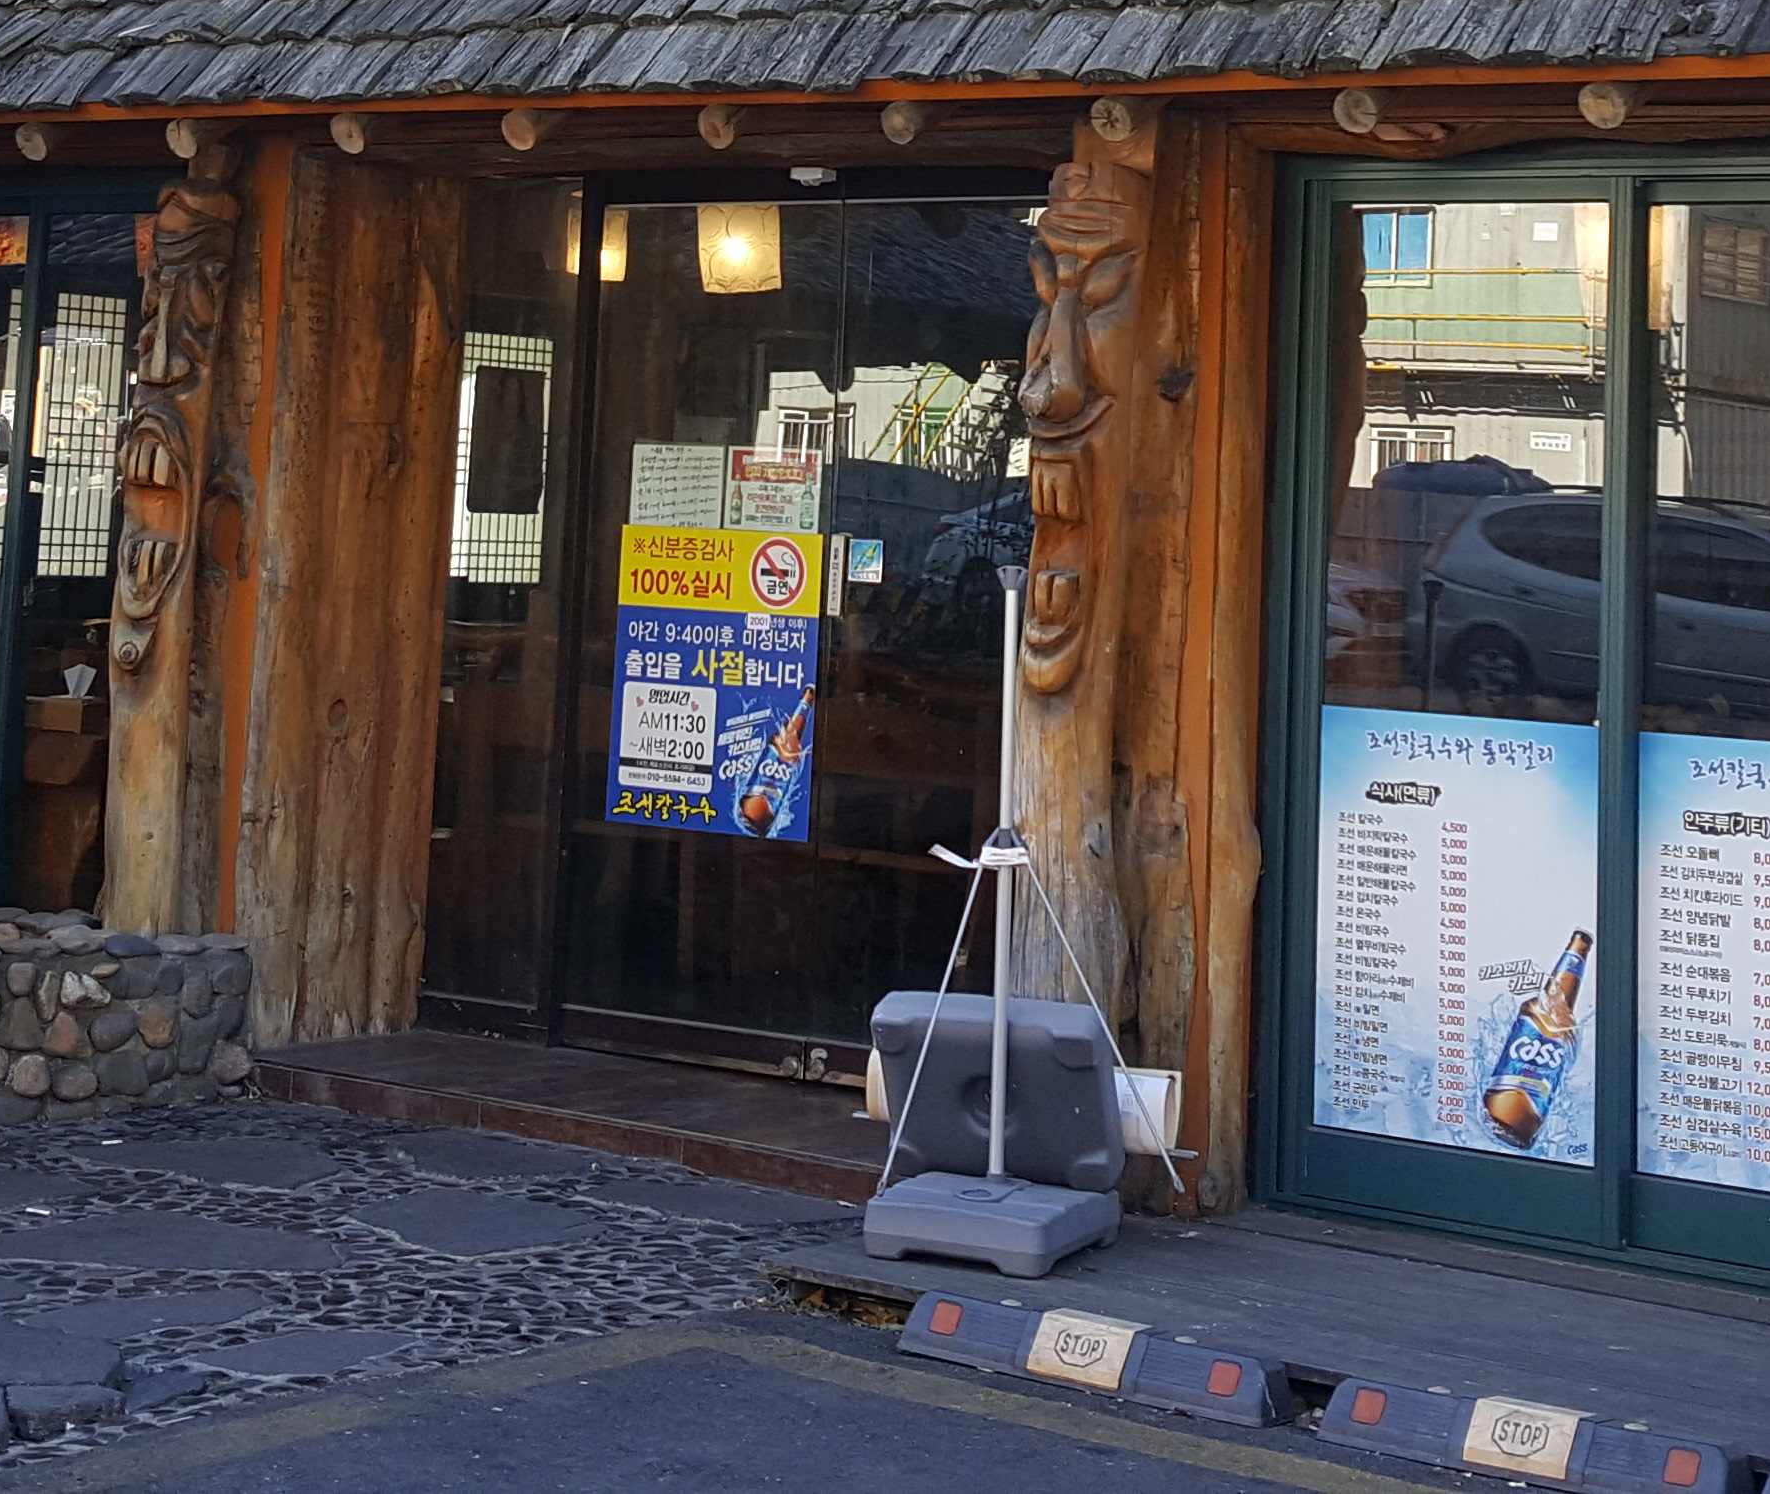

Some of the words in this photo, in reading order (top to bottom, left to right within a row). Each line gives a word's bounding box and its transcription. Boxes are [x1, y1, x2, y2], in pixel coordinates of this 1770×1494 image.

[631, 568, 732, 600] 100%실시
[766, 579, 789, 595] 금연
[628, 620, 659, 642] 야간
[665, 622, 734, 647] 9:40이후
[743, 628, 806, 653] 미성년자
[625, 649, 682, 679] 출입을
[691, 648, 804, 689] 사절합니다
[648, 688, 690, 705] 영업시간
[638, 712, 705, 733] AM11:30
[1366, 730, 1474, 765] 조선칼국수와
[1481, 739, 1554, 770] 통막걸리
[612, 792, 717, 824] 조선칼국수
[1338, 812, 1355, 824] 조선
[1441, 821, 1468, 834] 4,500
[1659, 962, 1683, 977] 조선
[1685, 964, 1731, 983] 순대볶음
[1659, 984, 1683, 999] 조선
[1685, 986, 1731, 1005] 두루치기
[1060, 1334, 1101, 1359] STOP
[1498, 1423, 1542, 1448] STOP
